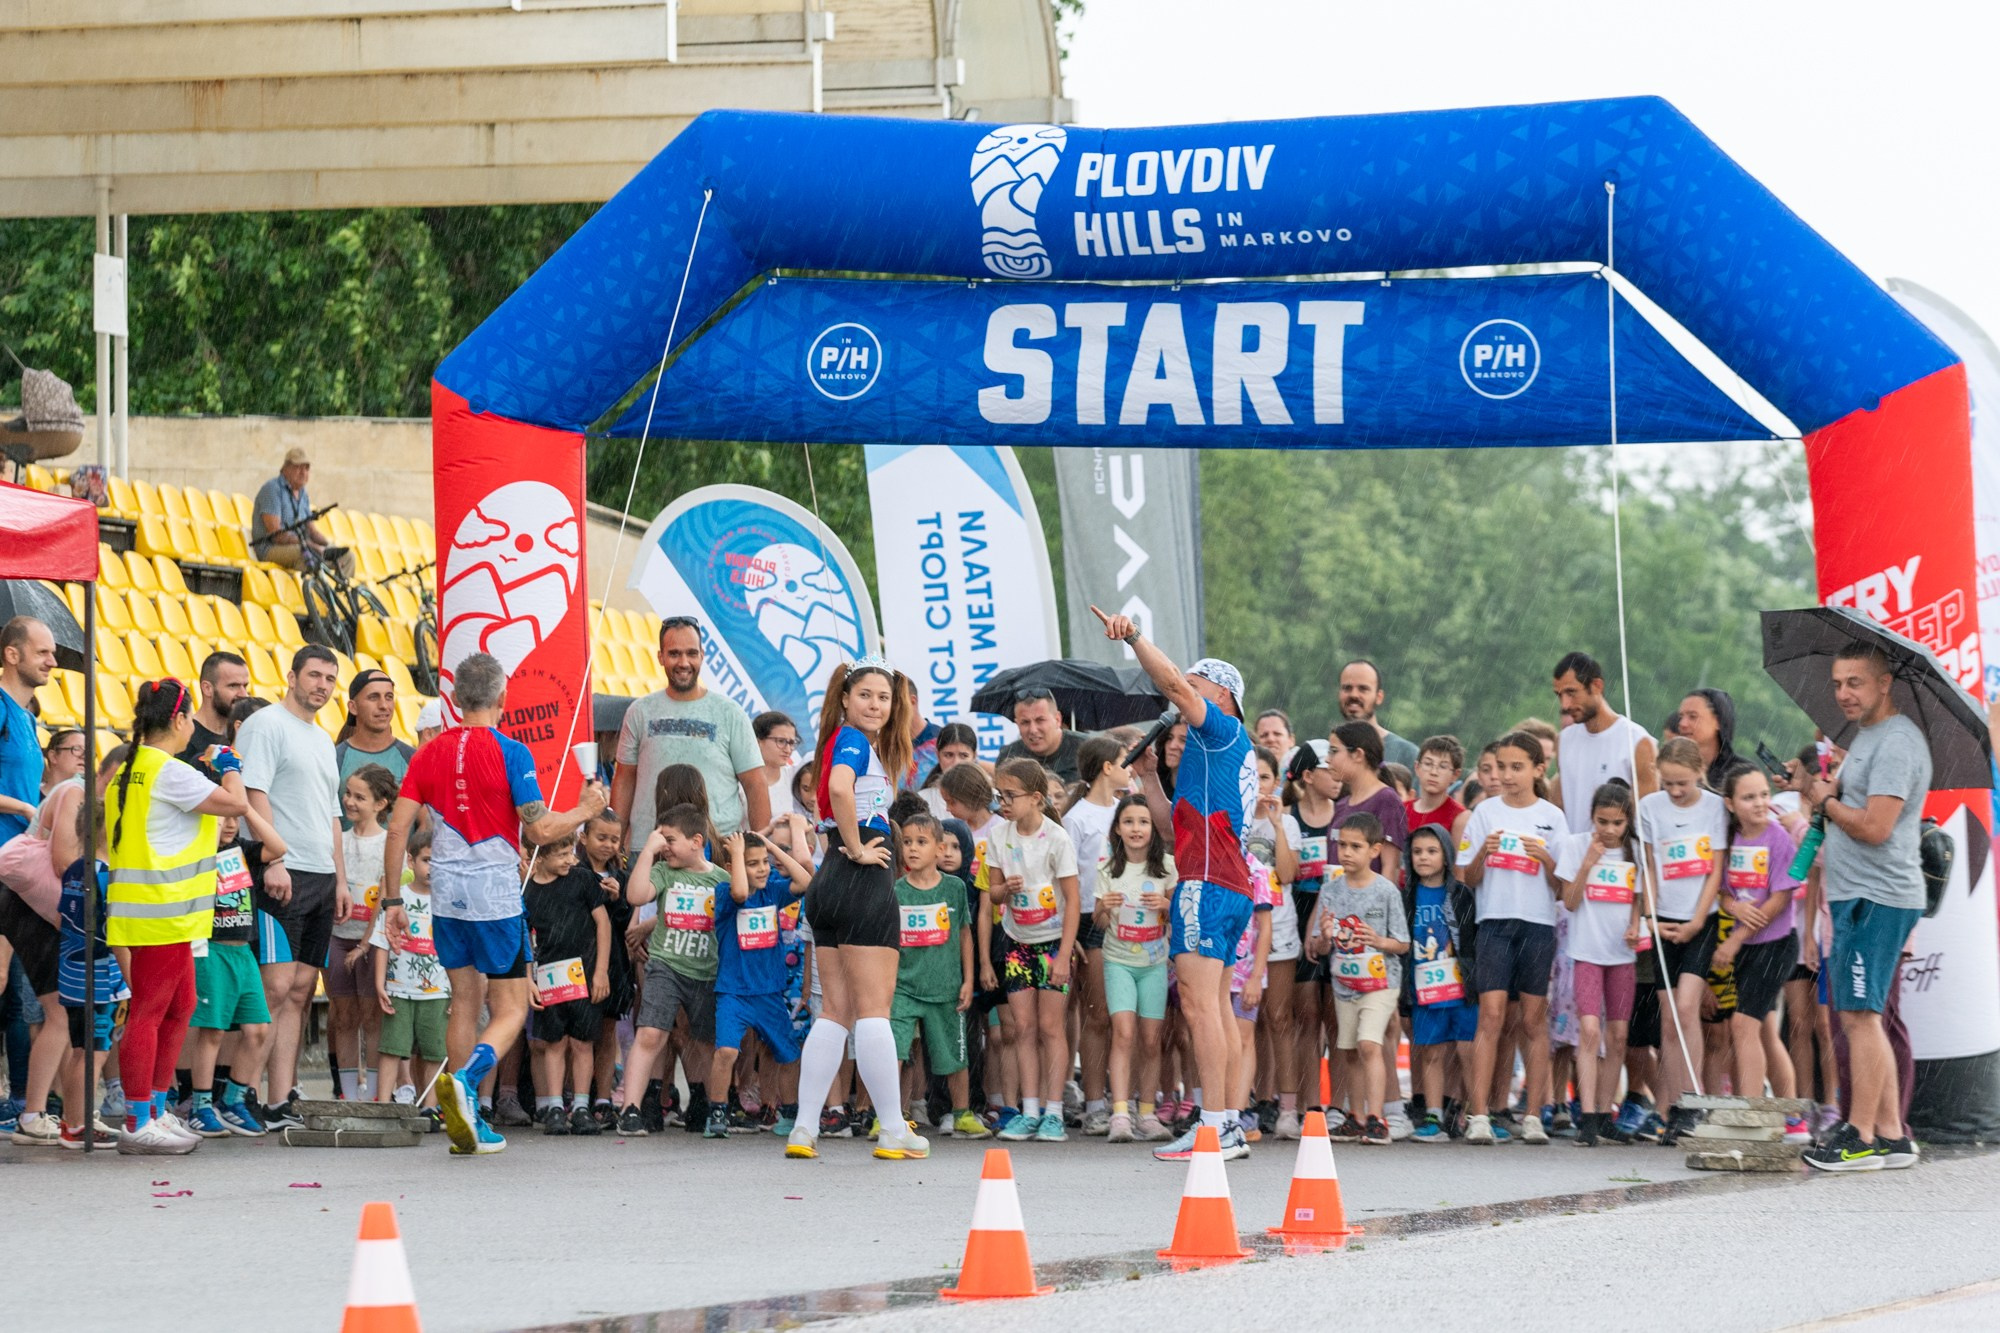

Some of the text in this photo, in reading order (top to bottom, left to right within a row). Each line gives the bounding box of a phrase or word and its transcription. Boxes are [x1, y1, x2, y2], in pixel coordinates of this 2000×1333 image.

[1074, 144, 1276, 198] PLOVDIV
[1216, 211, 1243, 227] IN
[1074, 208, 1206, 257] HILLS
[1220, 227, 1353, 248] MARKOVO
[820, 346, 870, 372] P/H
[978, 301, 1365, 425] START
[1474, 344, 1526, 370] P/H
[1474, 371, 1526, 379] MARKOVO
[497, 701, 559, 728] PLOVDIV
[511, 723, 555, 744] HILLS
[1668, 844, 1686, 860] 48
[216, 857, 241, 875] 105
[1597, 868, 1618, 883] 46
[676, 896, 695, 911] 27
[749, 915, 767, 930] 81
[907, 914, 927, 928] 85
[1134, 910, 1145, 925] 3
[663, 928, 710, 958] EVER
[1340, 962, 1360, 975] 60
[1424, 968, 1445, 984] 39
[547, 972, 554, 985] 1
[1851, 964, 1867, 999] NIKE
